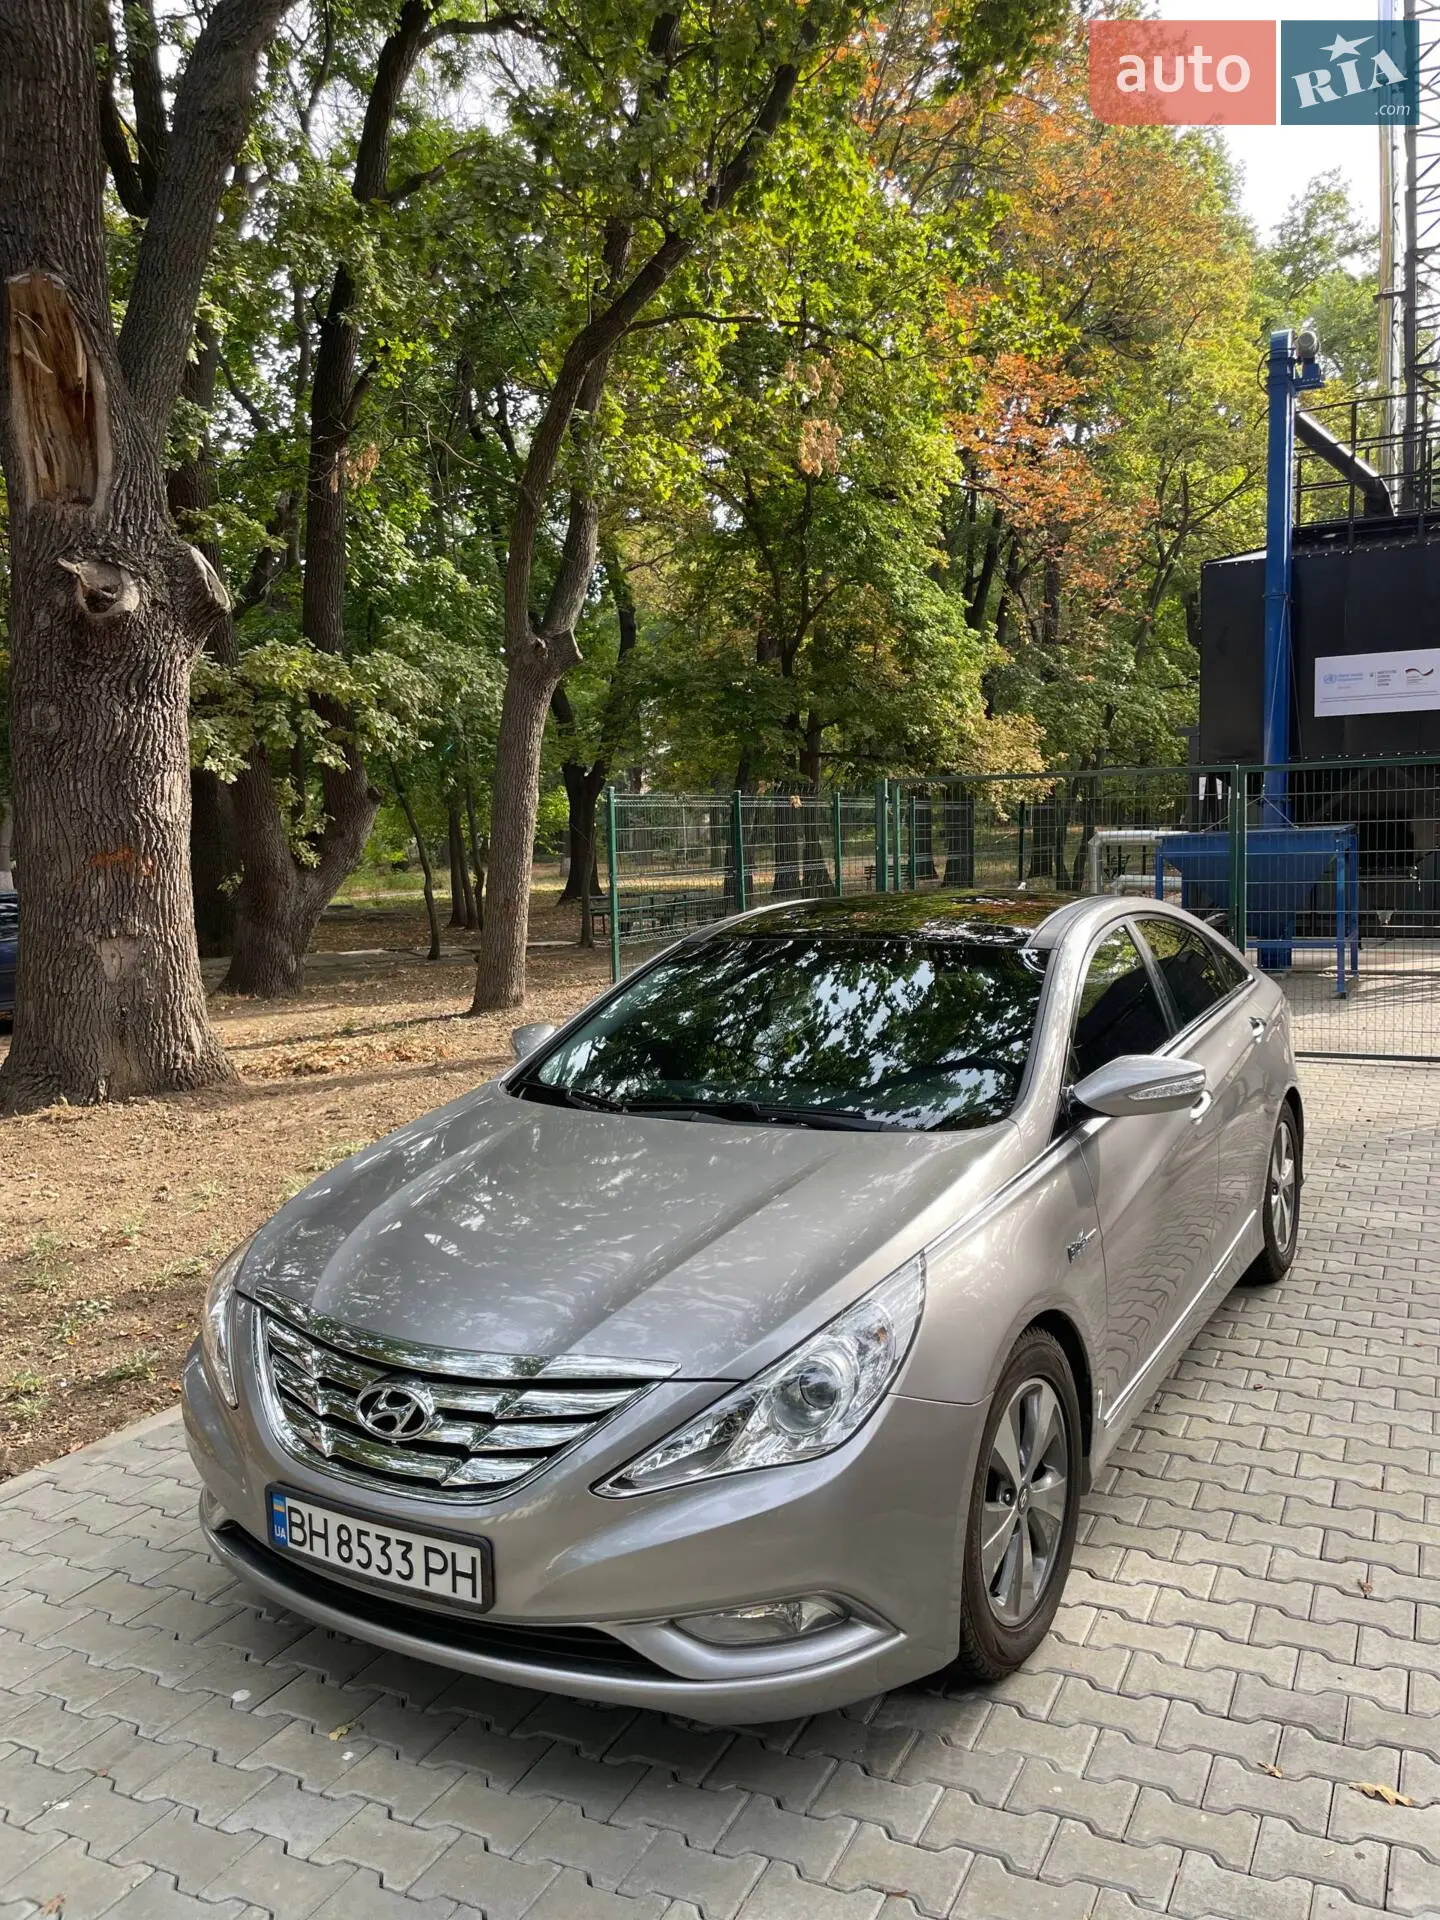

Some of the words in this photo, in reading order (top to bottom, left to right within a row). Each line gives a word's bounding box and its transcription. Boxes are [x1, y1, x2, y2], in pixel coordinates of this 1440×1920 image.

[274, 1526, 287, 1540] UA
[287, 1506, 330, 1558] BH
[336, 1524, 414, 1581] 8533
[424, 1545, 477, 1599] PH
